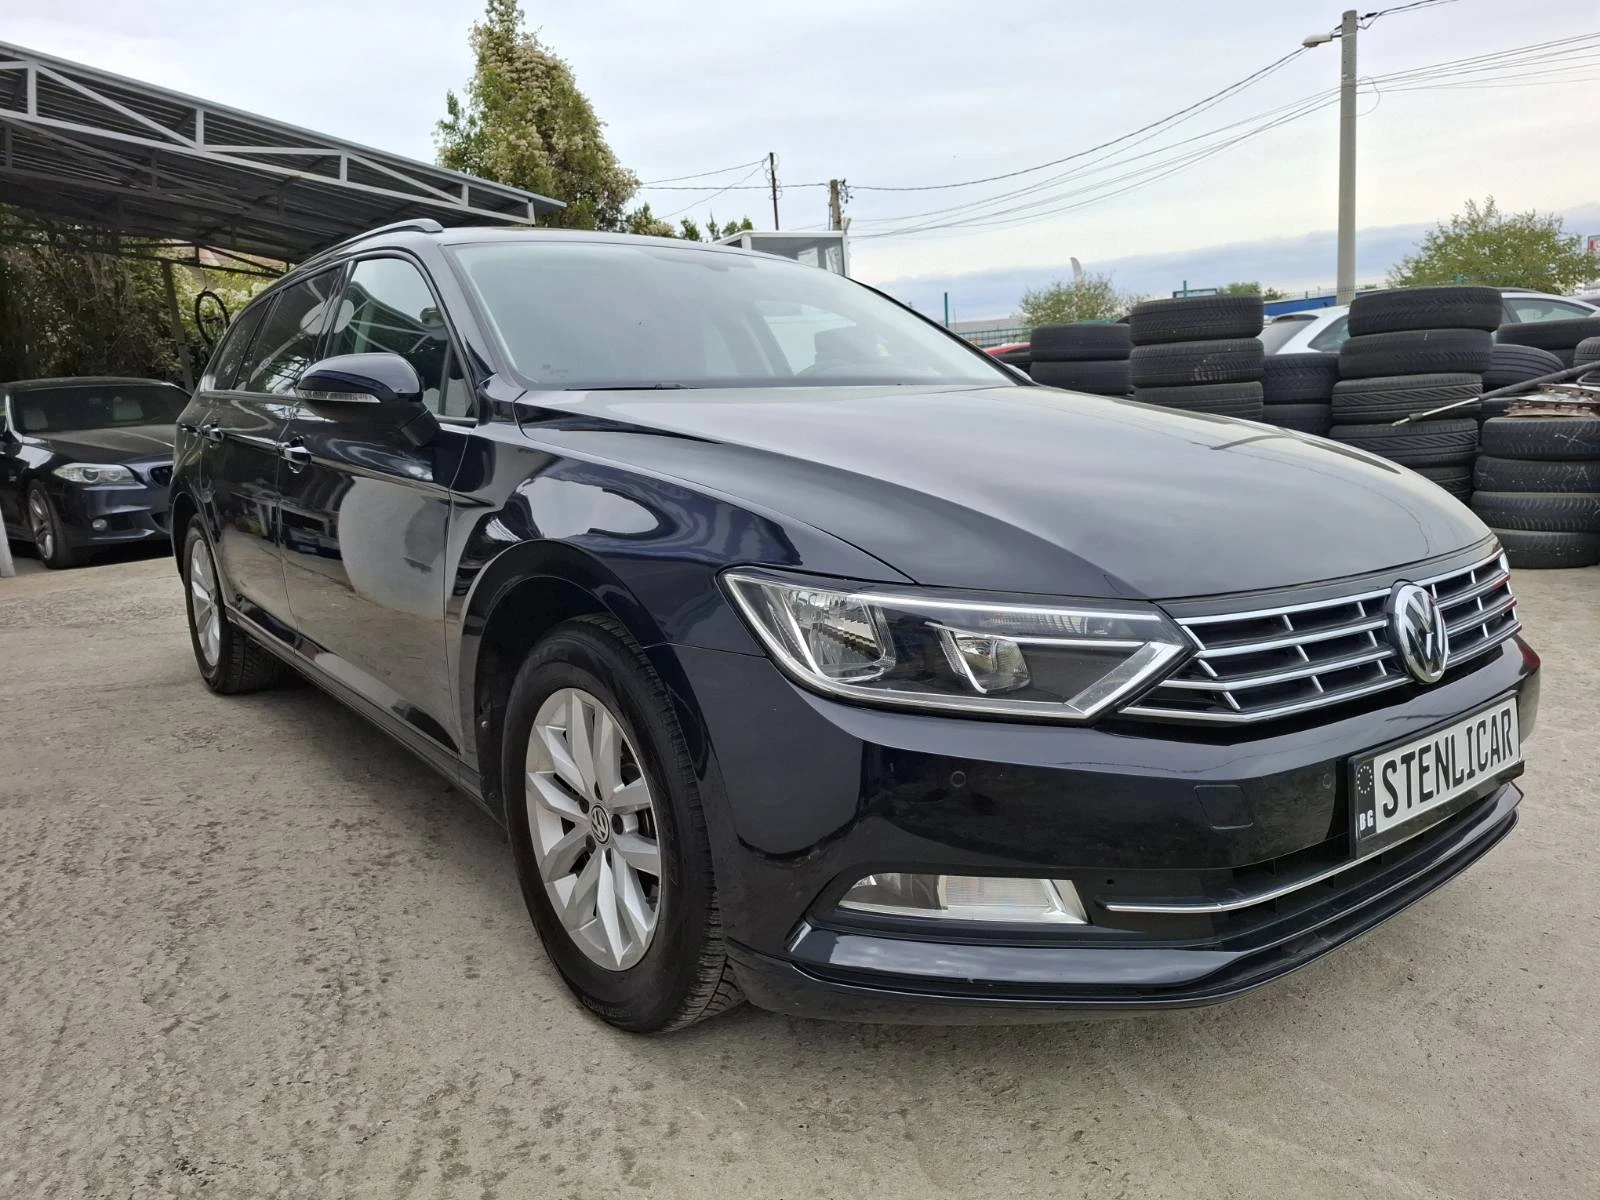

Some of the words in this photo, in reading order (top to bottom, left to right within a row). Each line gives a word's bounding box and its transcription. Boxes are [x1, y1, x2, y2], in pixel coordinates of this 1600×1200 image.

[1395, 584, 1448, 682] VW
[1381, 707, 1513, 819] STENLICAR
[1359, 809, 1374, 831] BG
